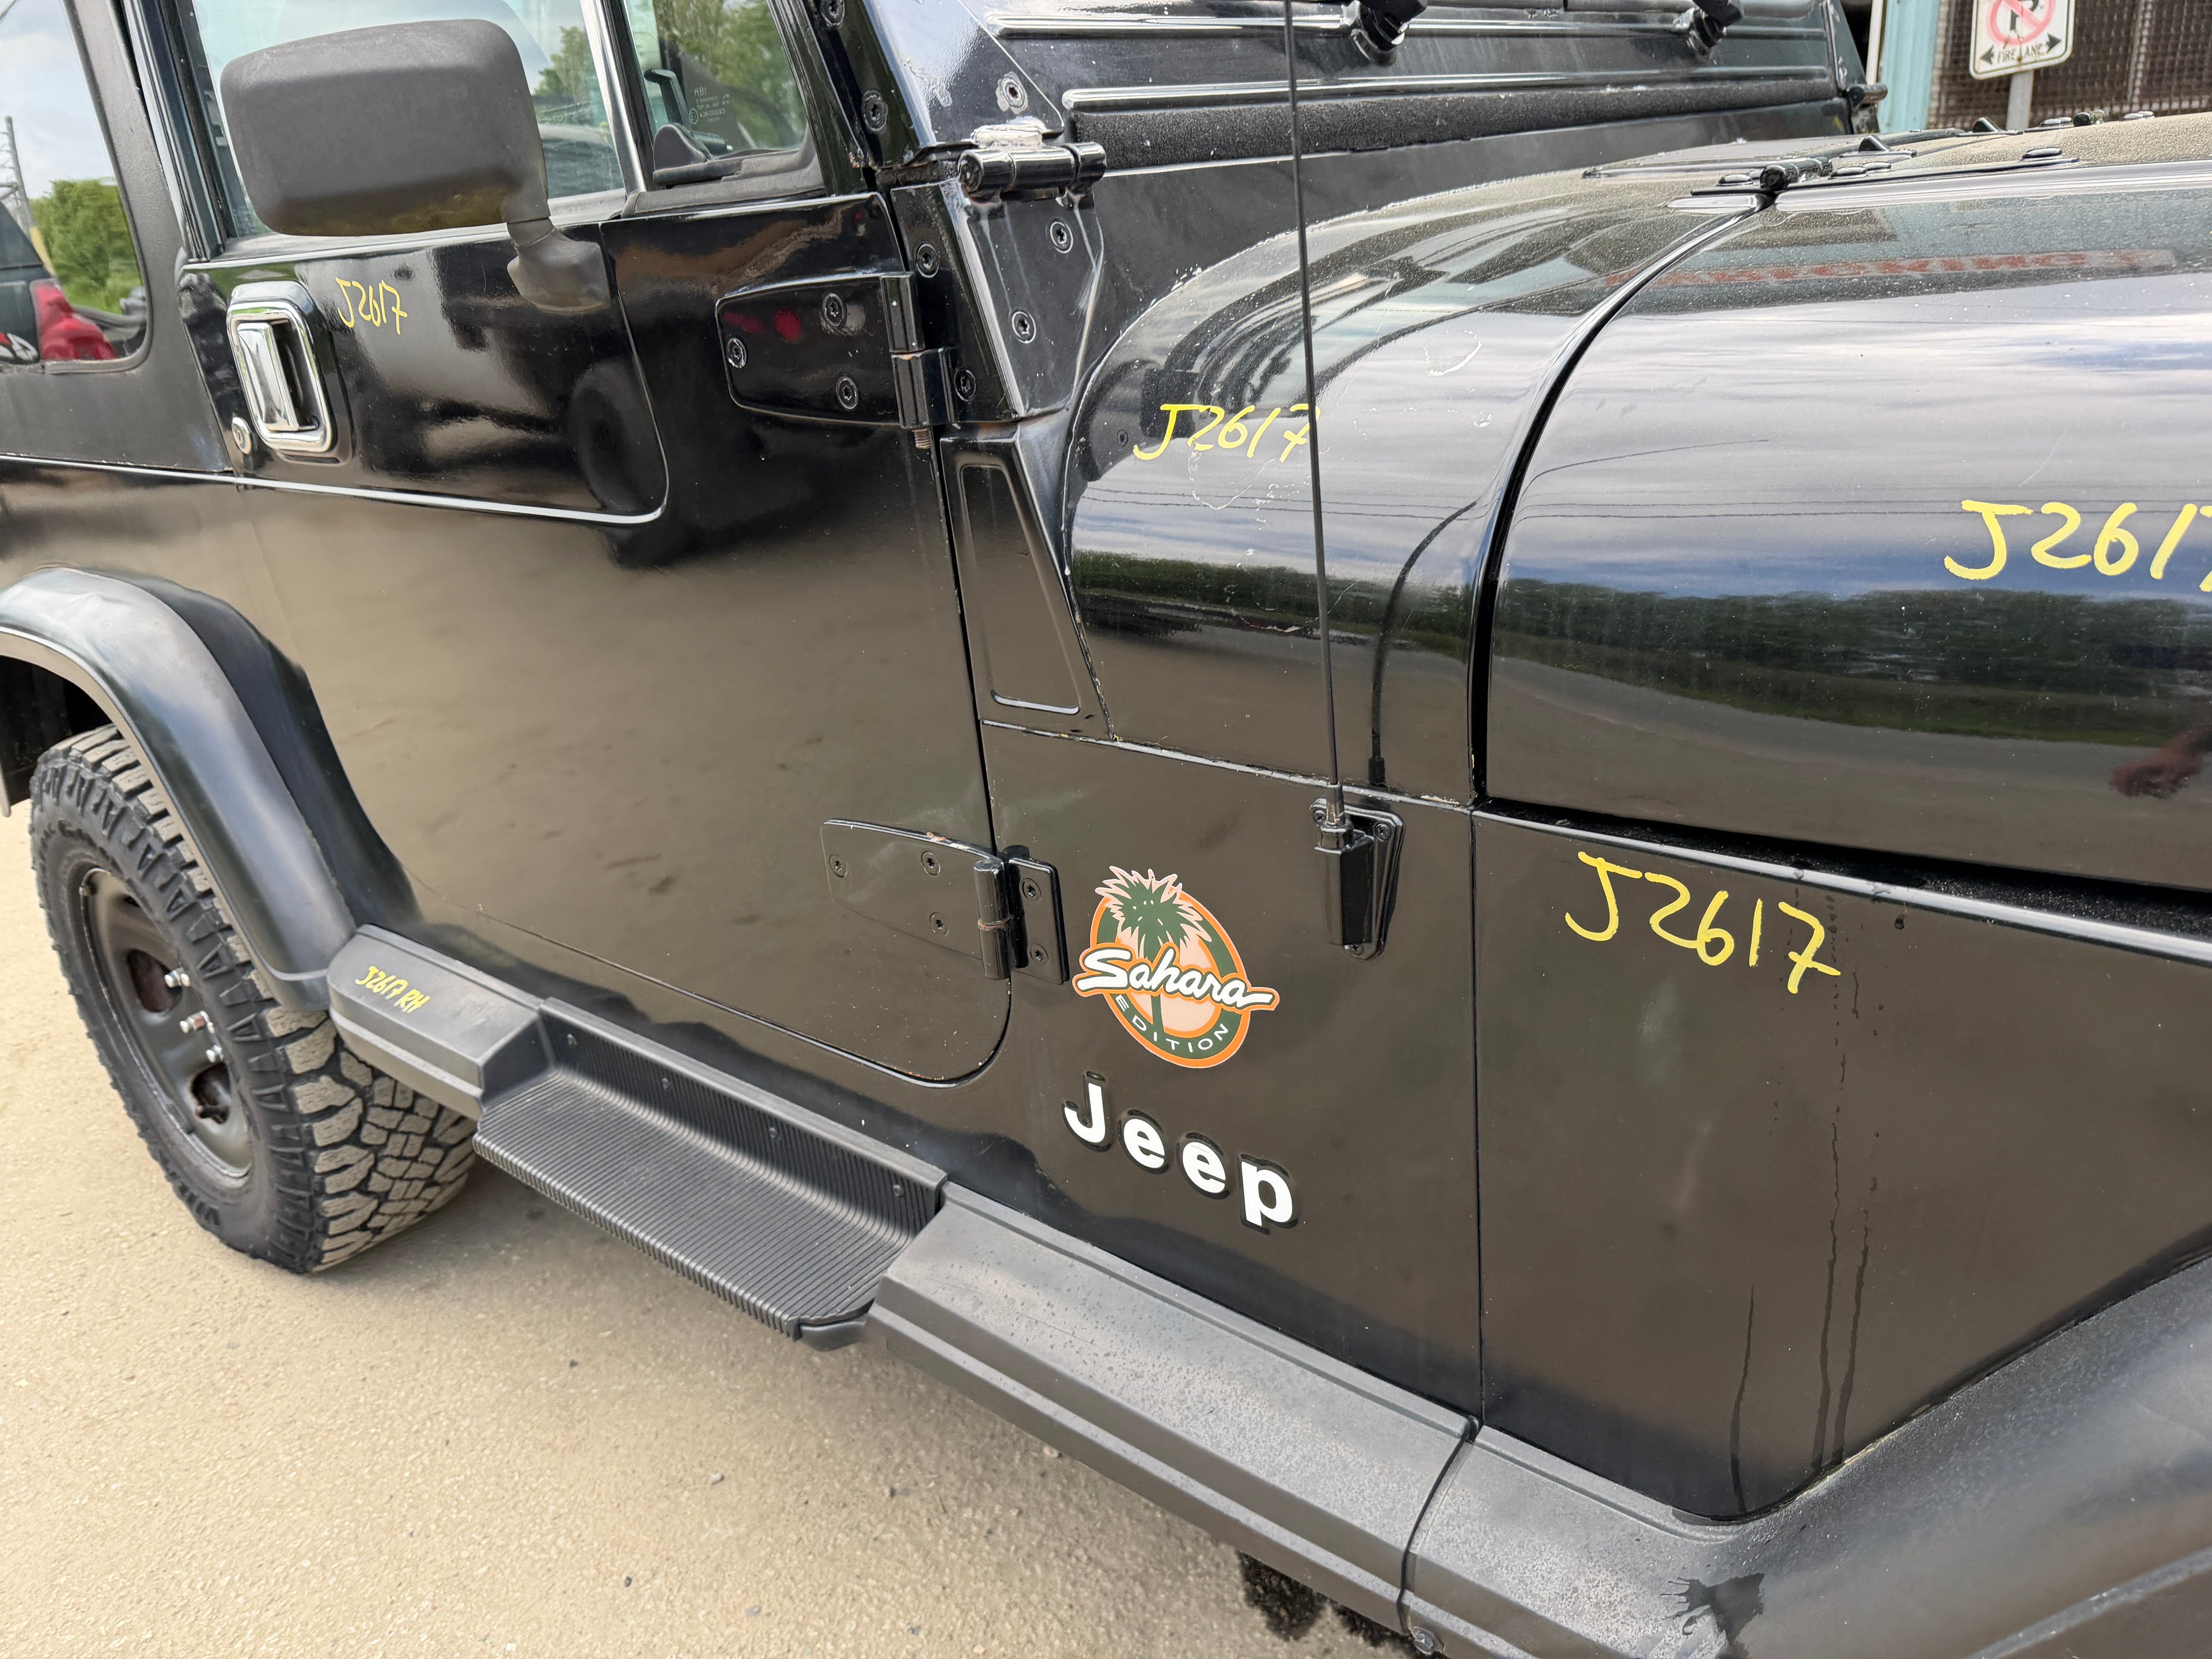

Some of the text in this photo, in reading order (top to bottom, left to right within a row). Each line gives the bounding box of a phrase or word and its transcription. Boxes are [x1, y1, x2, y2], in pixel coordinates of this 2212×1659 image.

[1997, 47, 2017, 64] FIRE
[335, 276, 408, 335] J2617
[1133, 403, 1321, 463] J2617
[1565, 851, 1841, 994] J2617
[355, 965, 431, 1013] J2617 RH
[1077, 948, 1274, 1007] Sahara
[1116, 993, 1229, 1053] EDITION
[1063, 1080, 1294, 1229] Jeep
